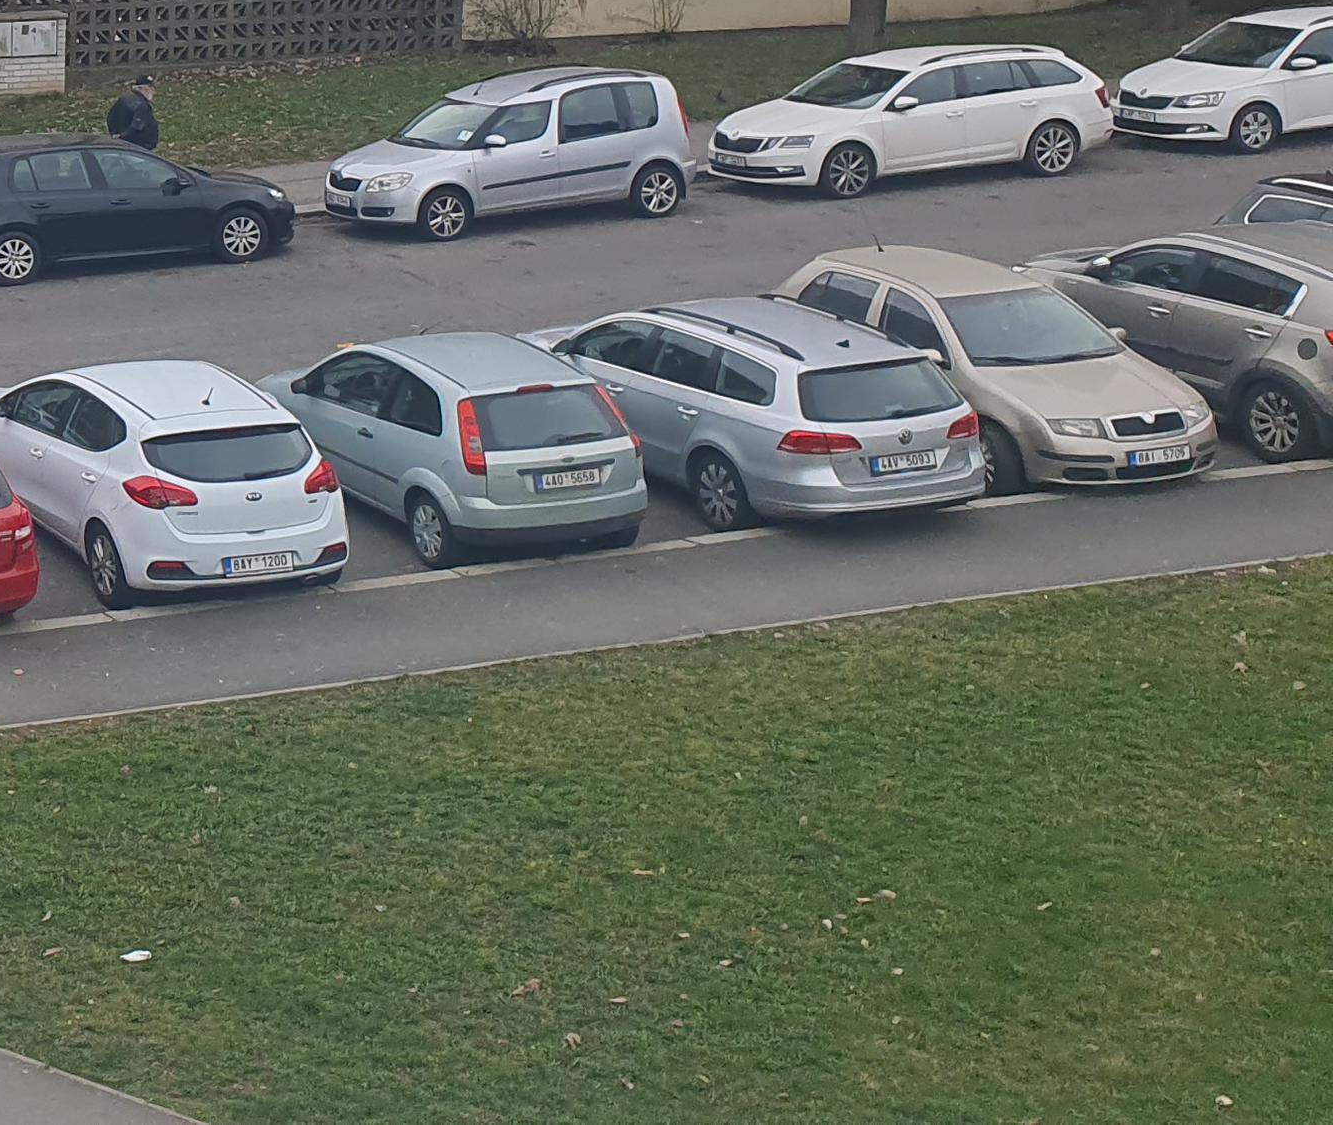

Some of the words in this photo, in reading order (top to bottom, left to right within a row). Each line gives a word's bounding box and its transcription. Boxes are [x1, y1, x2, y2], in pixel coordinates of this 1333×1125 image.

[906, 452, 931, 466] 5093
[233, 557, 253, 571] 8AY
[261, 554, 287, 568] 1200
